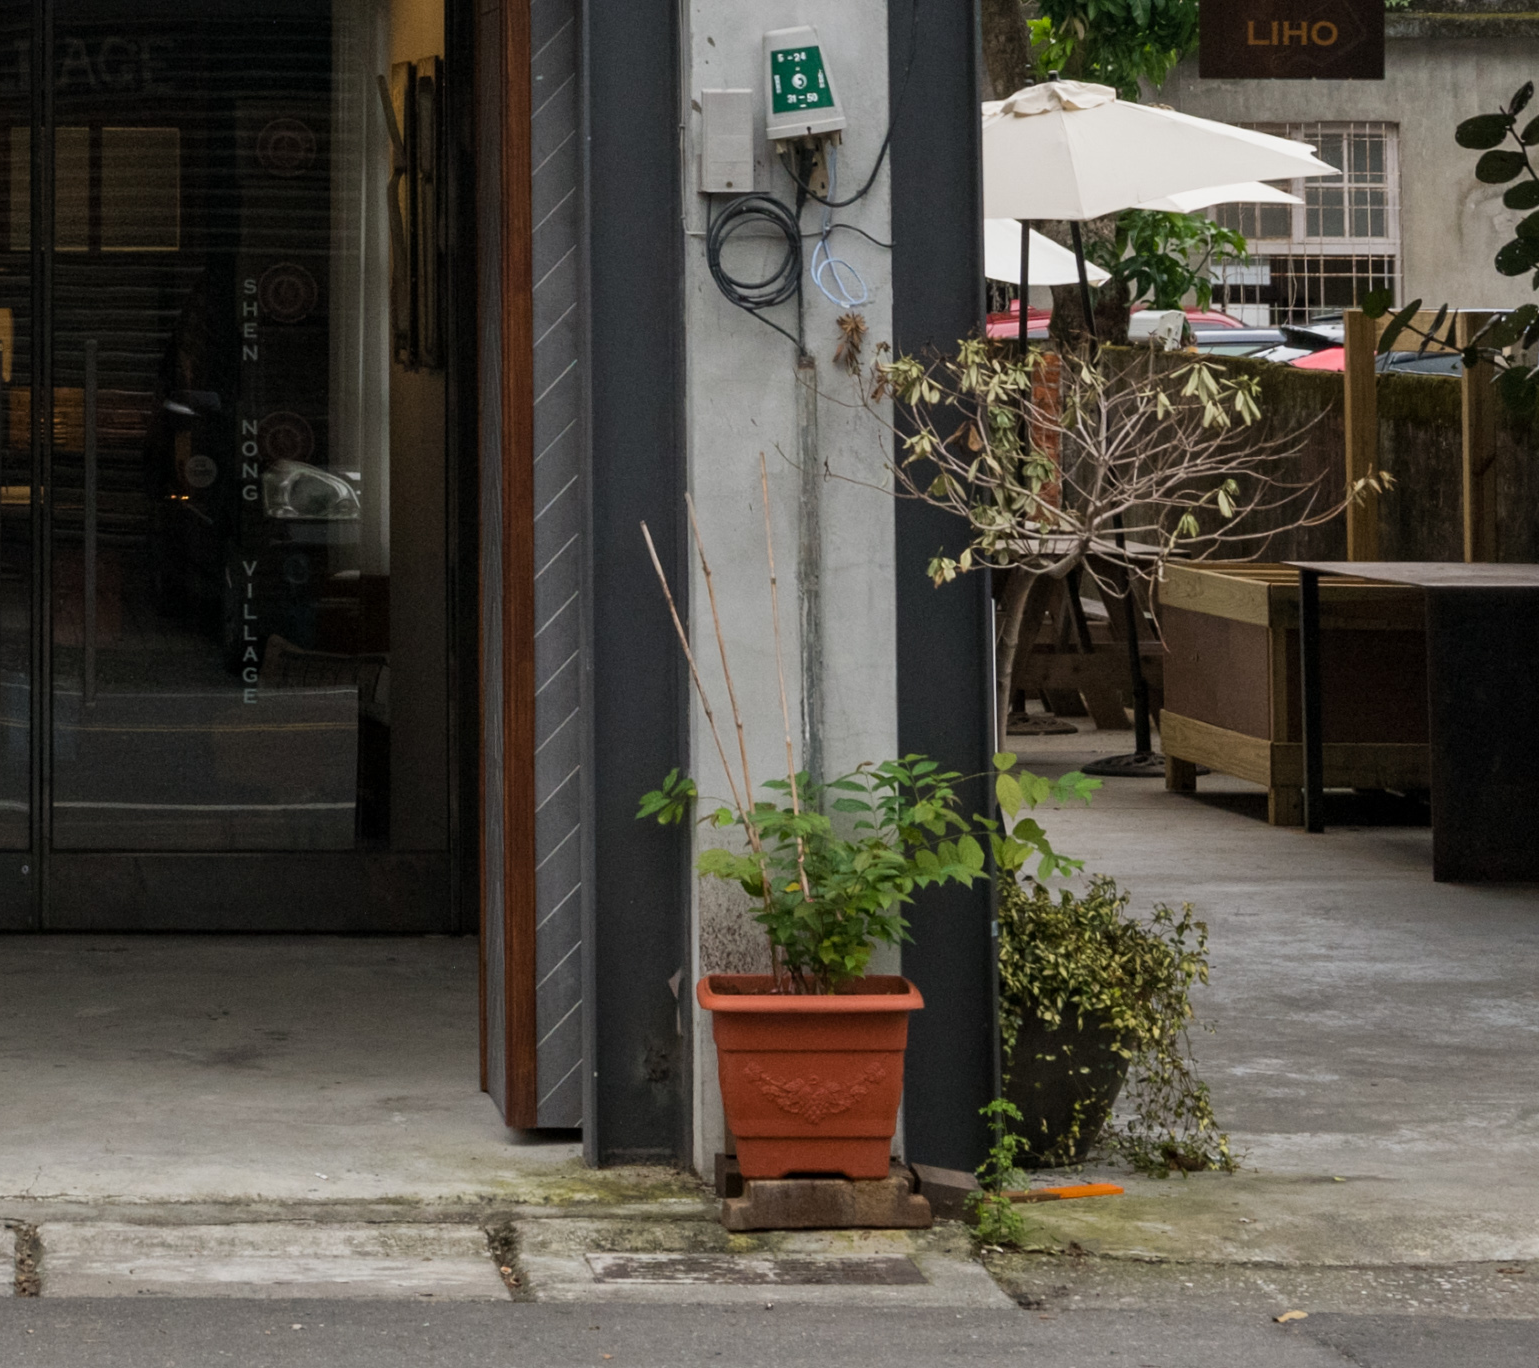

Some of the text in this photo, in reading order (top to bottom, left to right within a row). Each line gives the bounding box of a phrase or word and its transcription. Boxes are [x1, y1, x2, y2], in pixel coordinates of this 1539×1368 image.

[1247, 20, 1339, 47] LIHO
[241, 278, 259, 706] SHEN NONG VILLAGE
